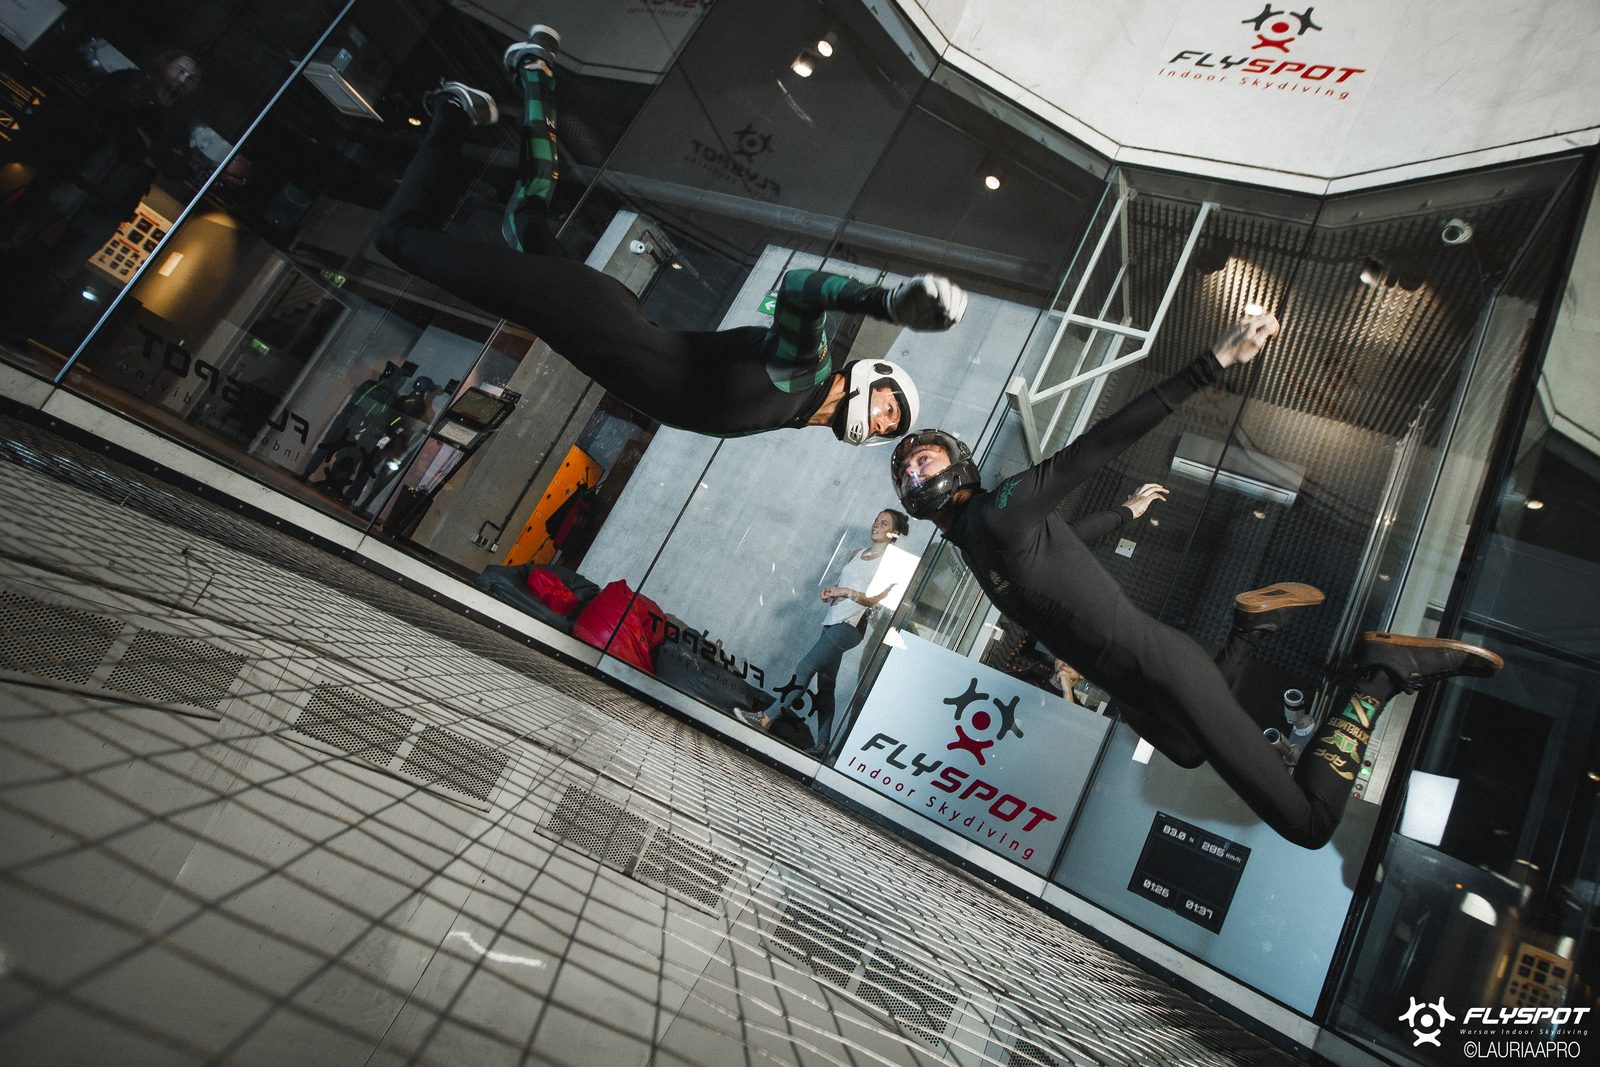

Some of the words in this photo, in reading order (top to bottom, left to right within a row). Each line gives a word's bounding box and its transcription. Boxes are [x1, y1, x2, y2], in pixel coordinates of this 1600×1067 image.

[1158, 67, 1227, 82] Indoor
[1241, 77, 1350, 100] Skydiving
[1169, 50, 1366, 84] FLYSPOT
[848, 757, 916, 797] Indoor
[926, 796, 1035, 860] Skydiving
[860, 733, 1058, 832] FLYSPOT
